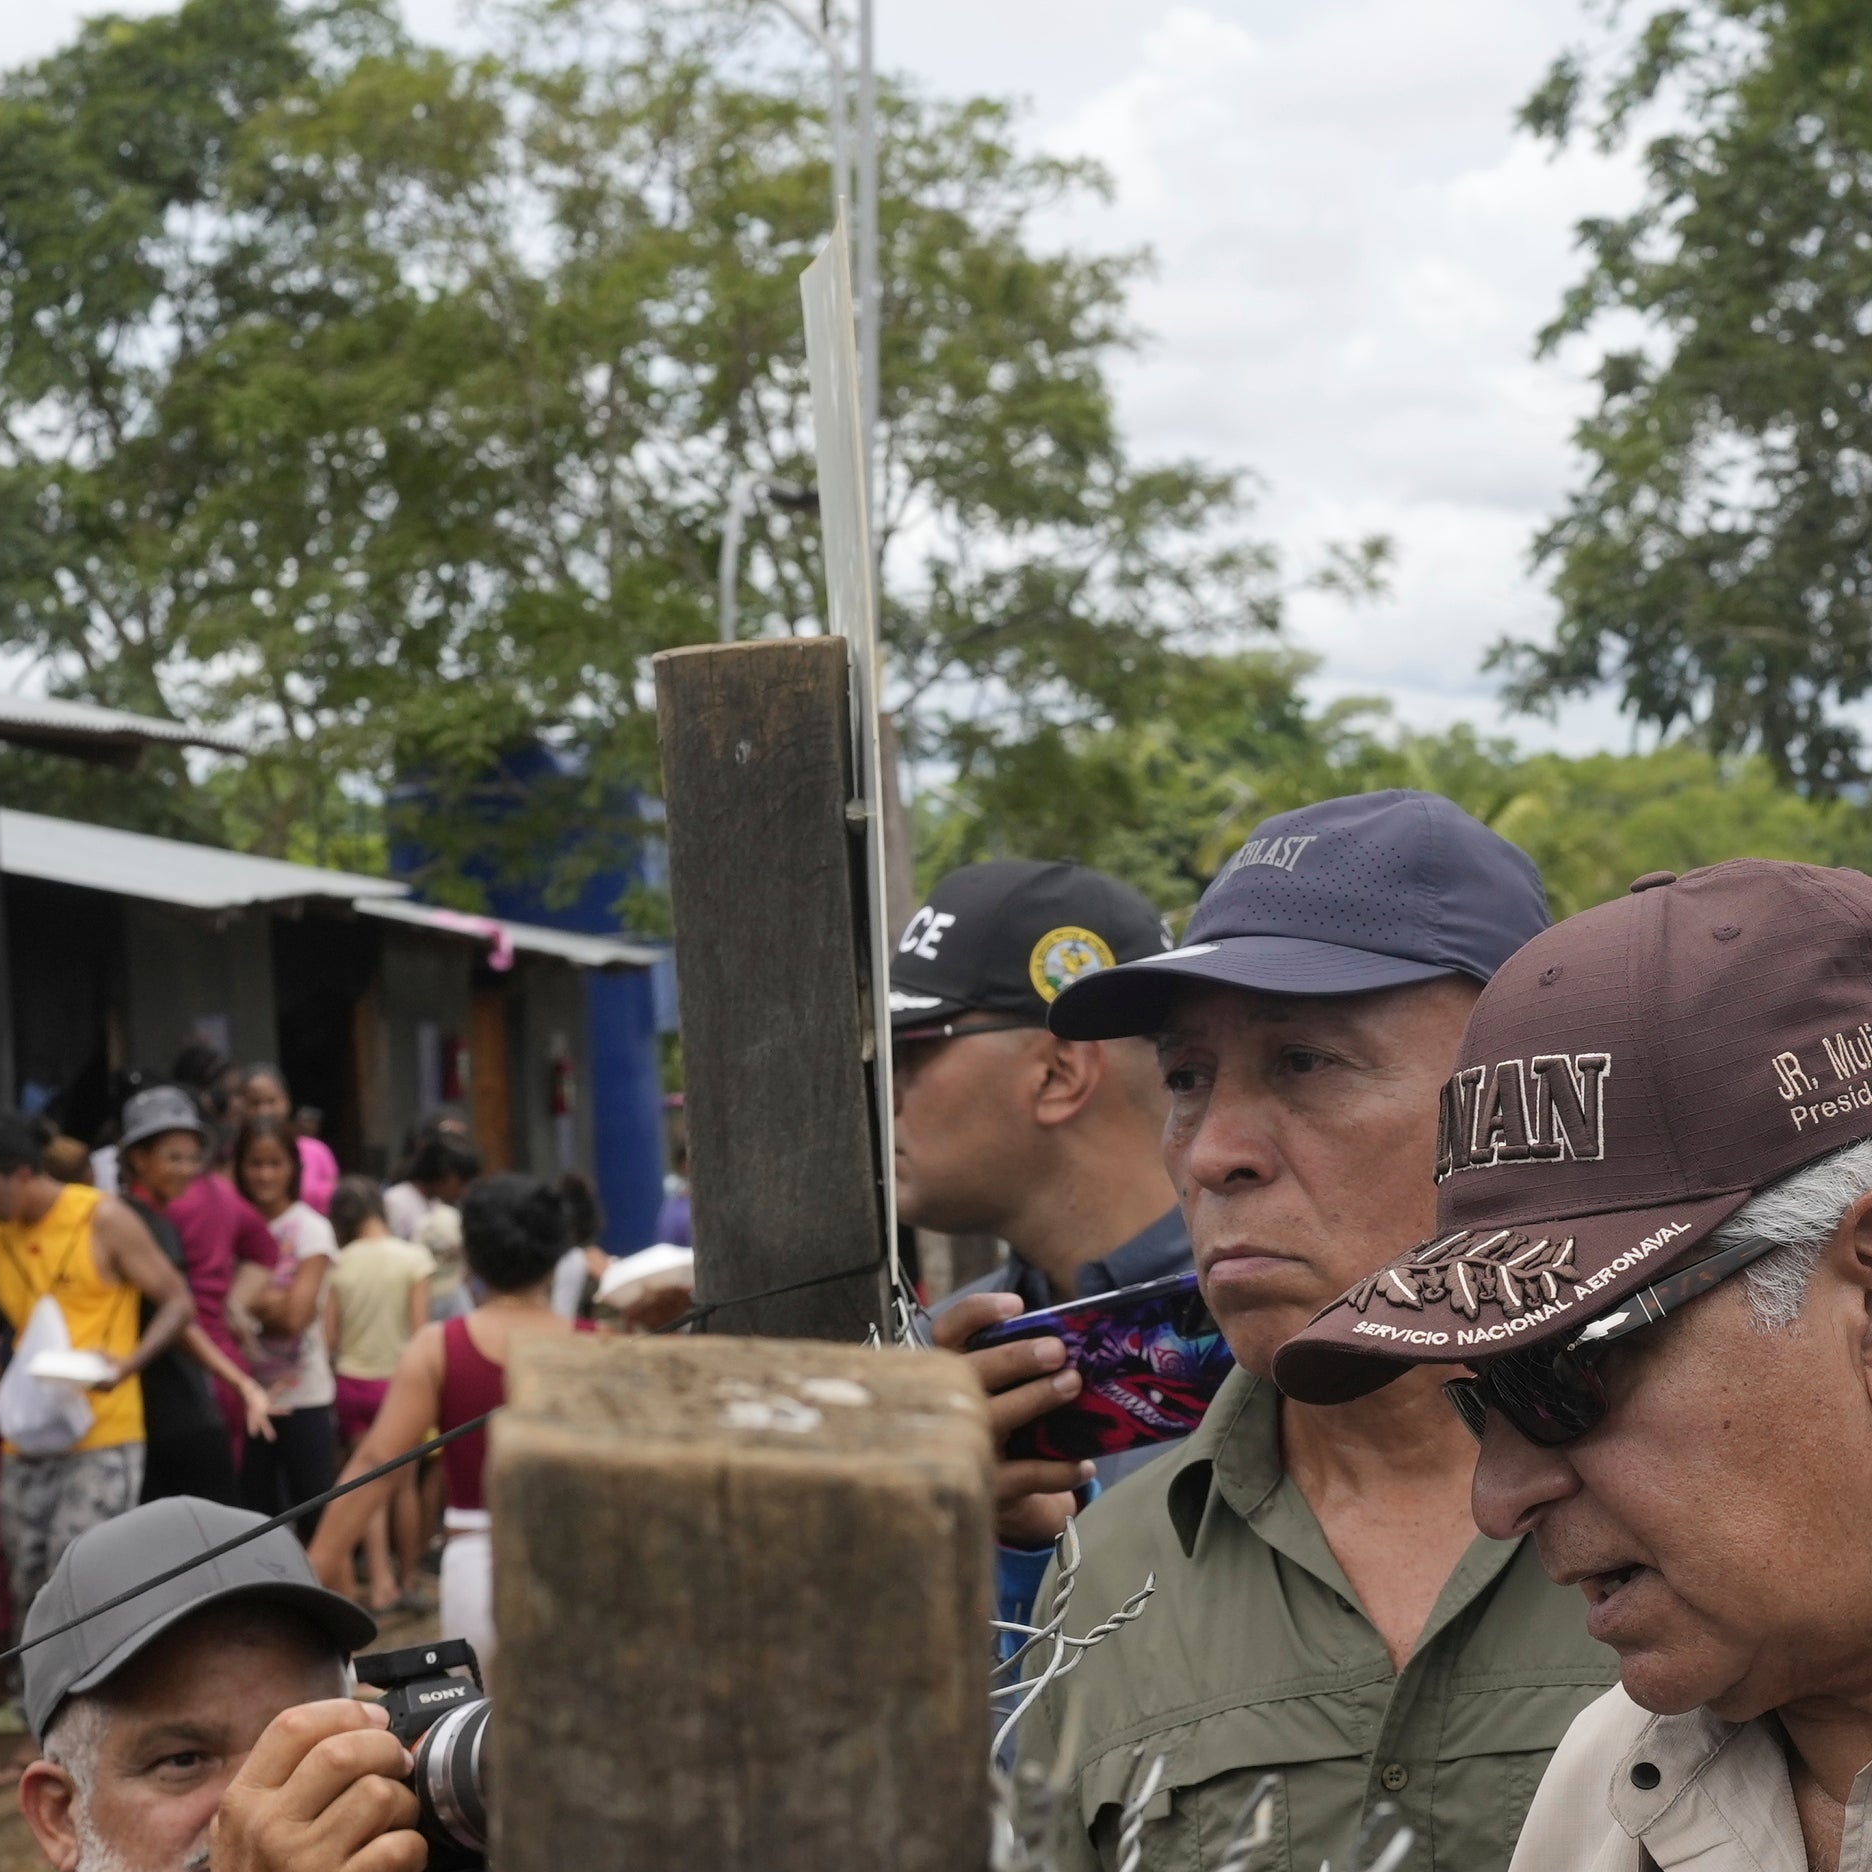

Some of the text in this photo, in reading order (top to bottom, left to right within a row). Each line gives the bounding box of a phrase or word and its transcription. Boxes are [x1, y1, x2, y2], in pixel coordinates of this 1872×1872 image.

[1352, 1220, 1693, 1346] SERVICIO NACIONAL AERONAVAL
[419, 1686, 466, 1704] SONY
